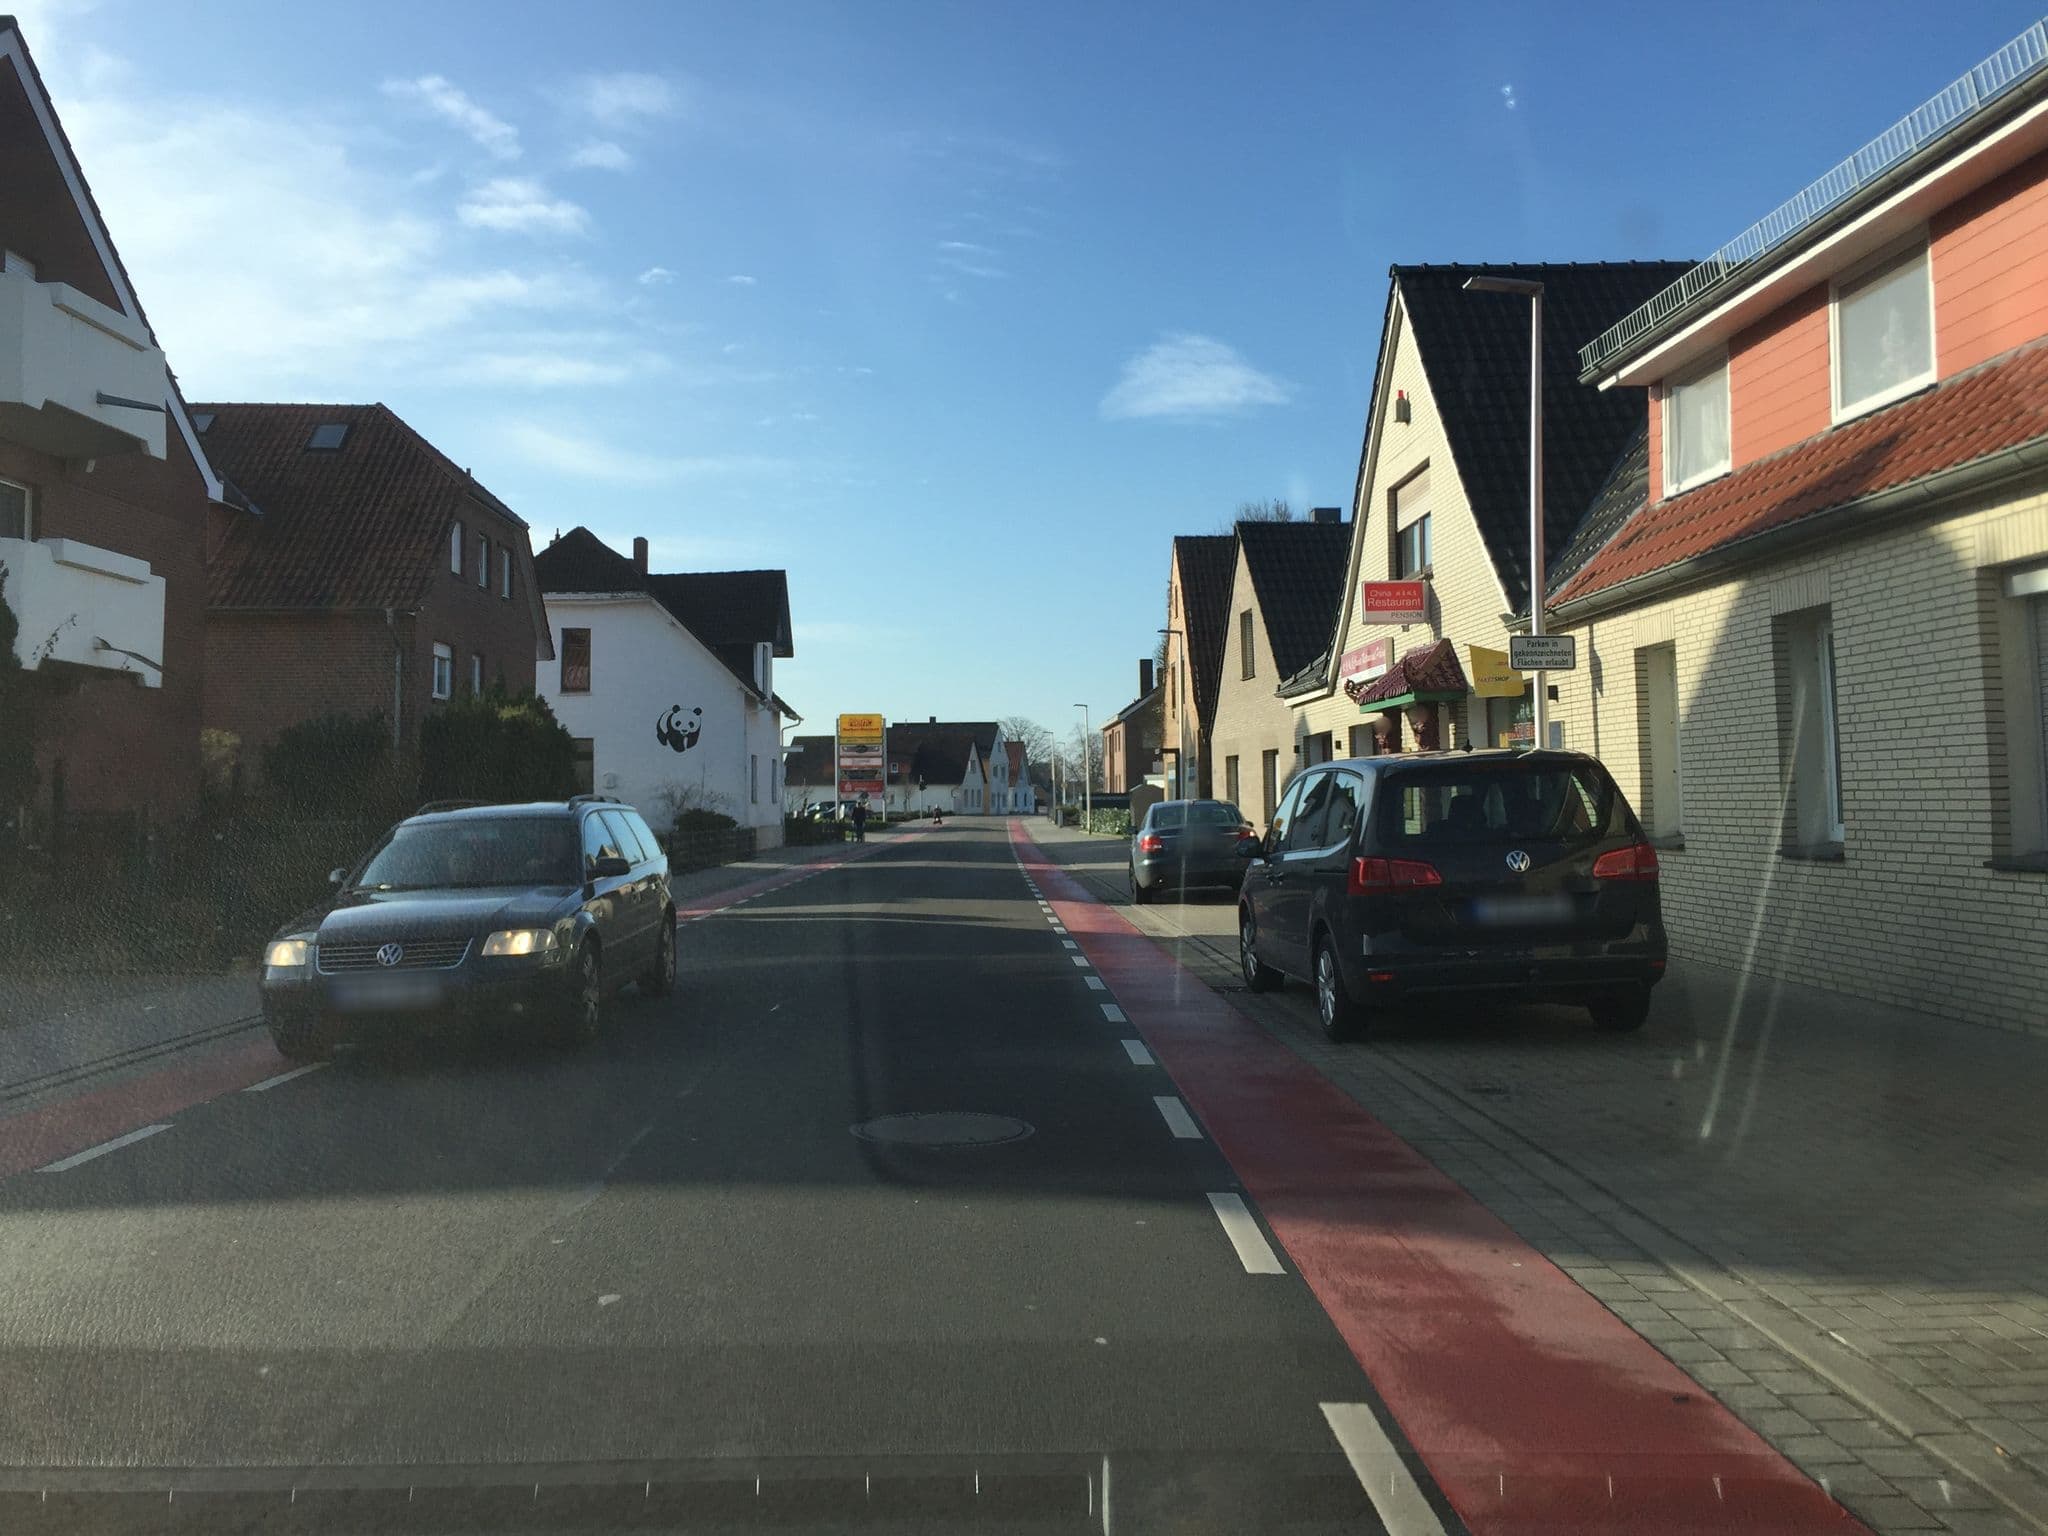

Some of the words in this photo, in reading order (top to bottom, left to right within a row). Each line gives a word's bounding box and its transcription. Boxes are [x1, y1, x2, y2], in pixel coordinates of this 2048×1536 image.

[1369, 589, 1392, 598] China
[1367, 598, 1421, 608] Restaurant
[1391, 610, 1423, 618] PENSION
[1526, 639, 1550, 648] Parken
[1551, 639, 1559, 648] in
[1513, 648, 1572, 658] gekennzeichneten
[1545, 657, 1570, 666] erlaubt
